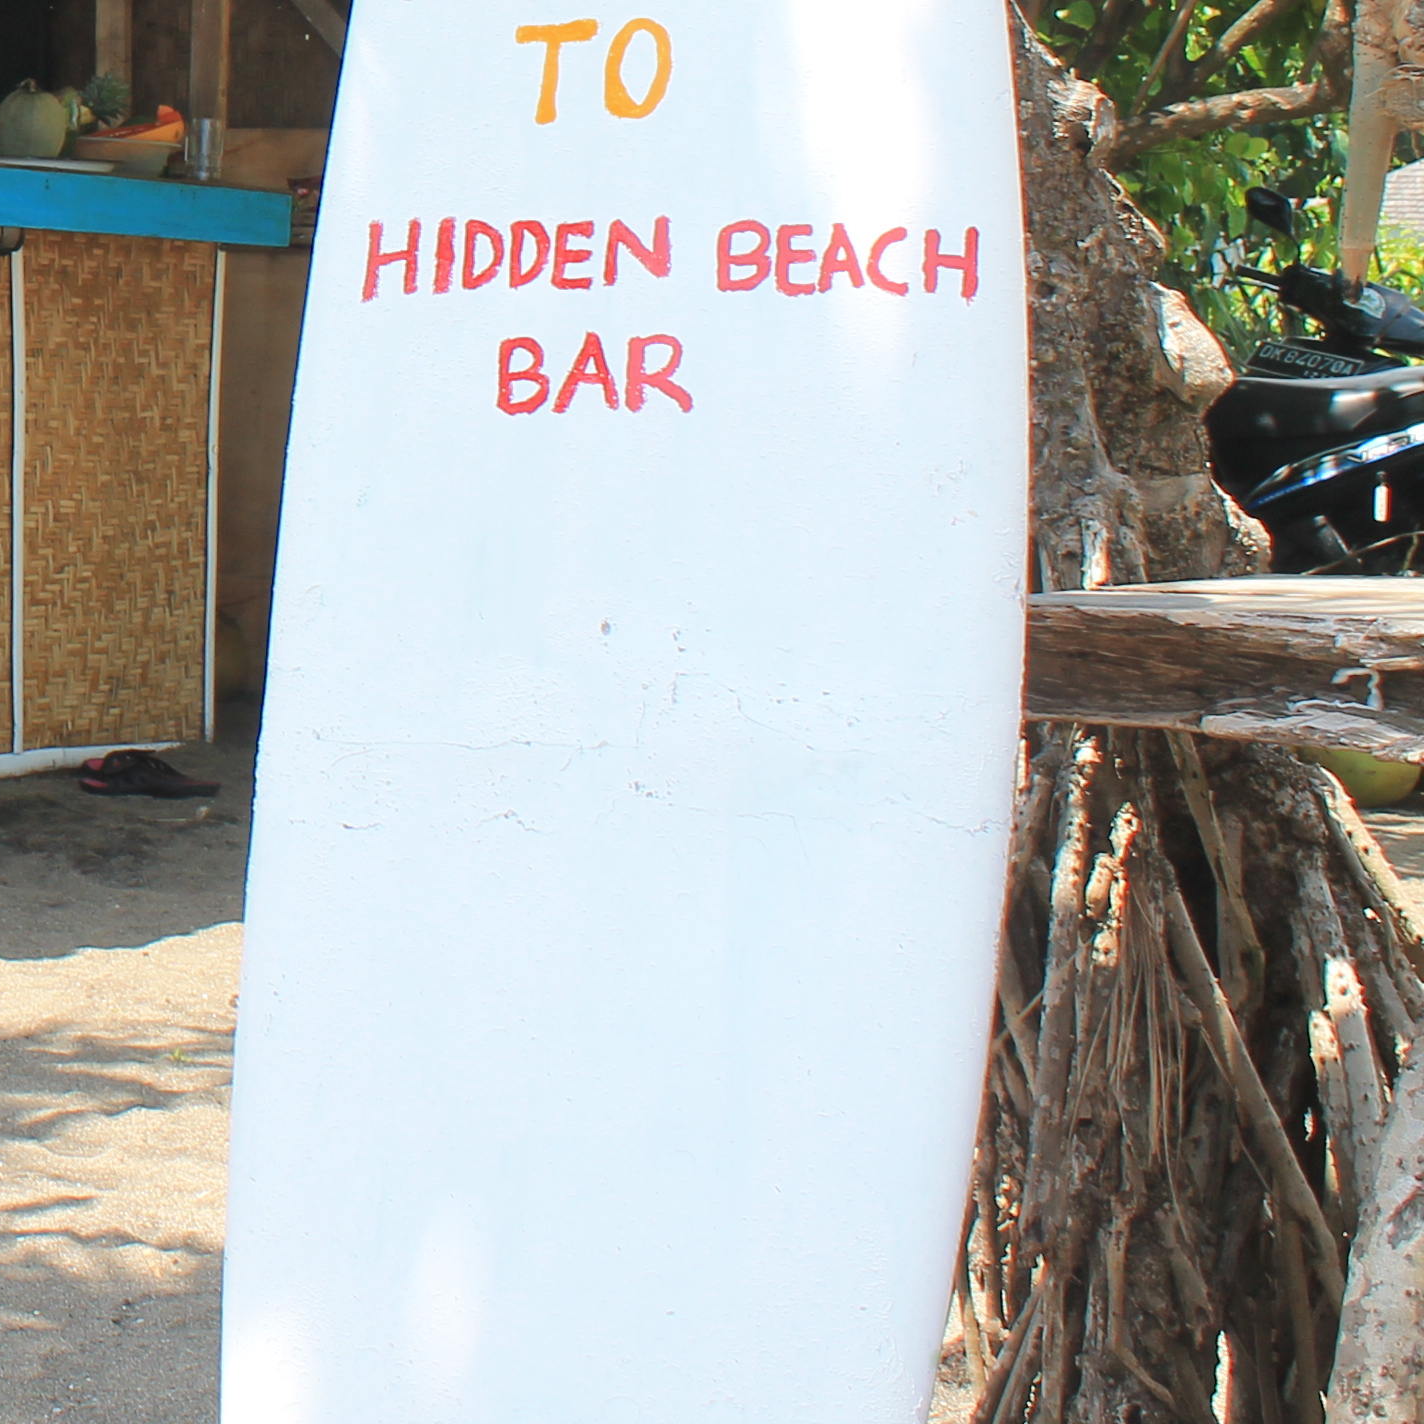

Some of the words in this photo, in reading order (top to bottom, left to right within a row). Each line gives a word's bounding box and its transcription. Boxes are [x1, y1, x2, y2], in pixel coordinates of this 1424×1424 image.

[514, 16, 674, 127] TO
[361, 215, 672, 303] HIDDEN
[714, 220, 982, 303] BEACH
[494, 330, 695, 417] BAR
